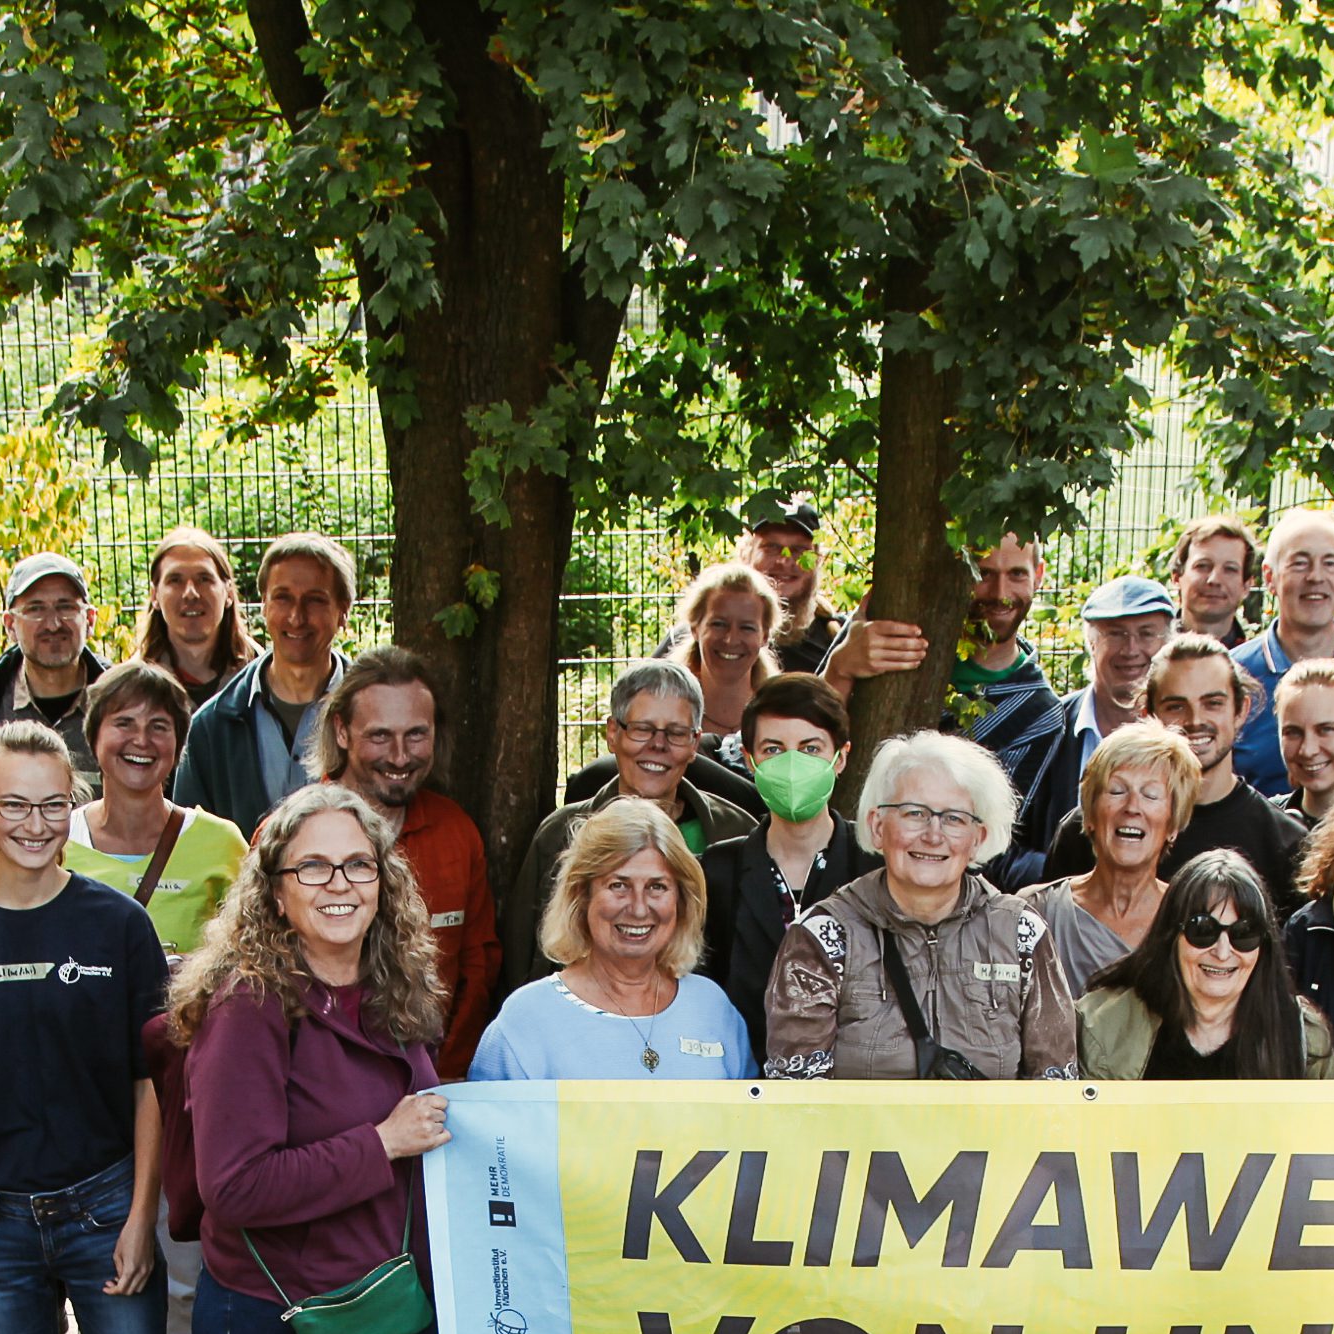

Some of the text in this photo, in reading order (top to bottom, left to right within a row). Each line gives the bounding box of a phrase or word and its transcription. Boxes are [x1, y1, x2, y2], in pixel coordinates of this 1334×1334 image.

[489, 1165, 499, 1196] MEHR
[497, 1136, 509, 1197] DEMOKRATIE
[491, 1248, 502, 1311] Umweltinstitut
[499, 1249, 510, 1306] München e.V.
